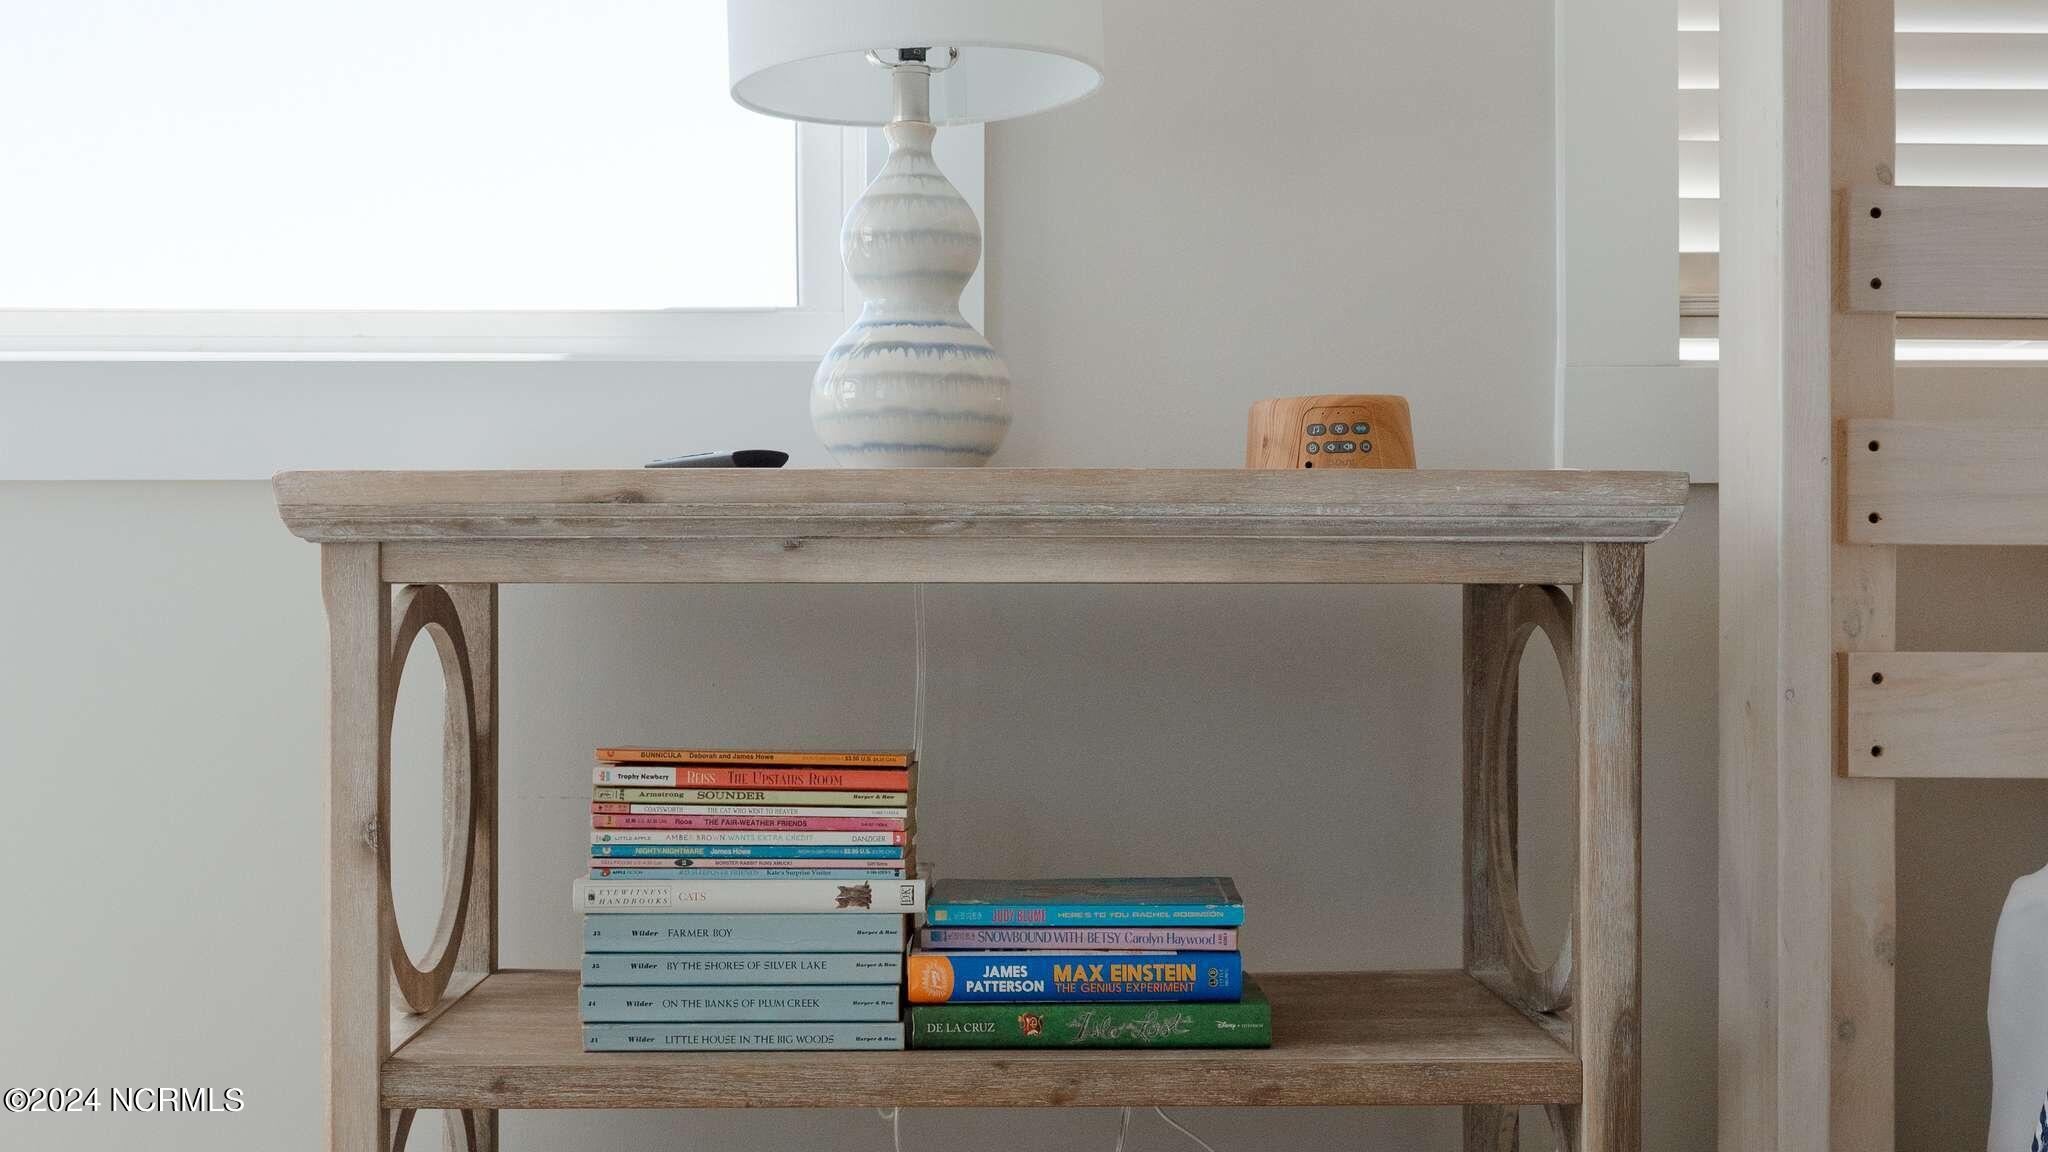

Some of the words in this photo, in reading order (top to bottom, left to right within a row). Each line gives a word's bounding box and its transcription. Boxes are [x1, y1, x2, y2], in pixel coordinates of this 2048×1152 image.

[617, 773, 639, 781] Trophy
[641, 773, 669, 781] Newbery
[687, 770, 716, 784] REISS
[728, 770, 748, 785] THE
[753, 771, 804, 786] UPSTAIRS
[808, 773, 843, 786] ROOM
[640, 791, 684, 799] Armstrong
[697, 791, 765, 800] SOUNDER
[598, 888, 668, 896] EYEWITNESS
[678, 892, 707, 901] CATS
[598, 897, 668, 905] HANDBOOKS
[992, 909, 1014, 923] JUDY
[1016, 909, 1047, 923] BLUME
[632, 929, 659, 937] Wilder
[667, 928, 709, 938] FARMER
[712, 927, 734, 938] BOY
[977, 931, 1051, 944] SNOWBOUND
[1053, 931, 1083, 943] WITH
[1087, 931, 1122, 944] BETSY
[1124, 932, 1165, 946] Carolyn
[1166, 932, 1216, 946] Haywood
[666, 961, 679, 970] BY
[682, 961, 701, 970] THE
[704, 961, 745, 970] SHORES
[747, 961, 761, 970] OF
[763, 961, 797, 970] SILVER
[800, 961, 828, 970] LAKE
[982, 965, 1028, 978] JAMES
[1053, 964, 1104, 982] MAX
[1110, 964, 1197, 982] EINSTEIN
[966, 980, 1045, 993] PATTERSON
[1055, 982, 1076, 993] THE
[1080, 982, 1122, 993] GENIUS
[1126, 982, 1195, 993] EXPERIMENT
[662, 999, 679, 1008] ON
[682, 999, 701, 1008] THE
[704, 999, 739, 1008] BANKS
[741, 999, 756, 1008] OF
[758, 999, 785, 1008] PLUM
[787, 999, 820, 1008] CREEK
[927, 1023, 944, 1033] DE
[946, 1023, 962, 1033] LA
[963, 1023, 996, 1033] CRUZ
[1215, 1020, 1237, 1031] Disney
[665, 1035, 699, 1044] LITTLE
[701, 1035, 736, 1044] HOUSE
[739, 1035, 751, 1044] IN
[754, 1035, 774, 1044] THE
[777, 1035, 794, 1044] BIG
[796, 1034, 835, 1044] WOODS
